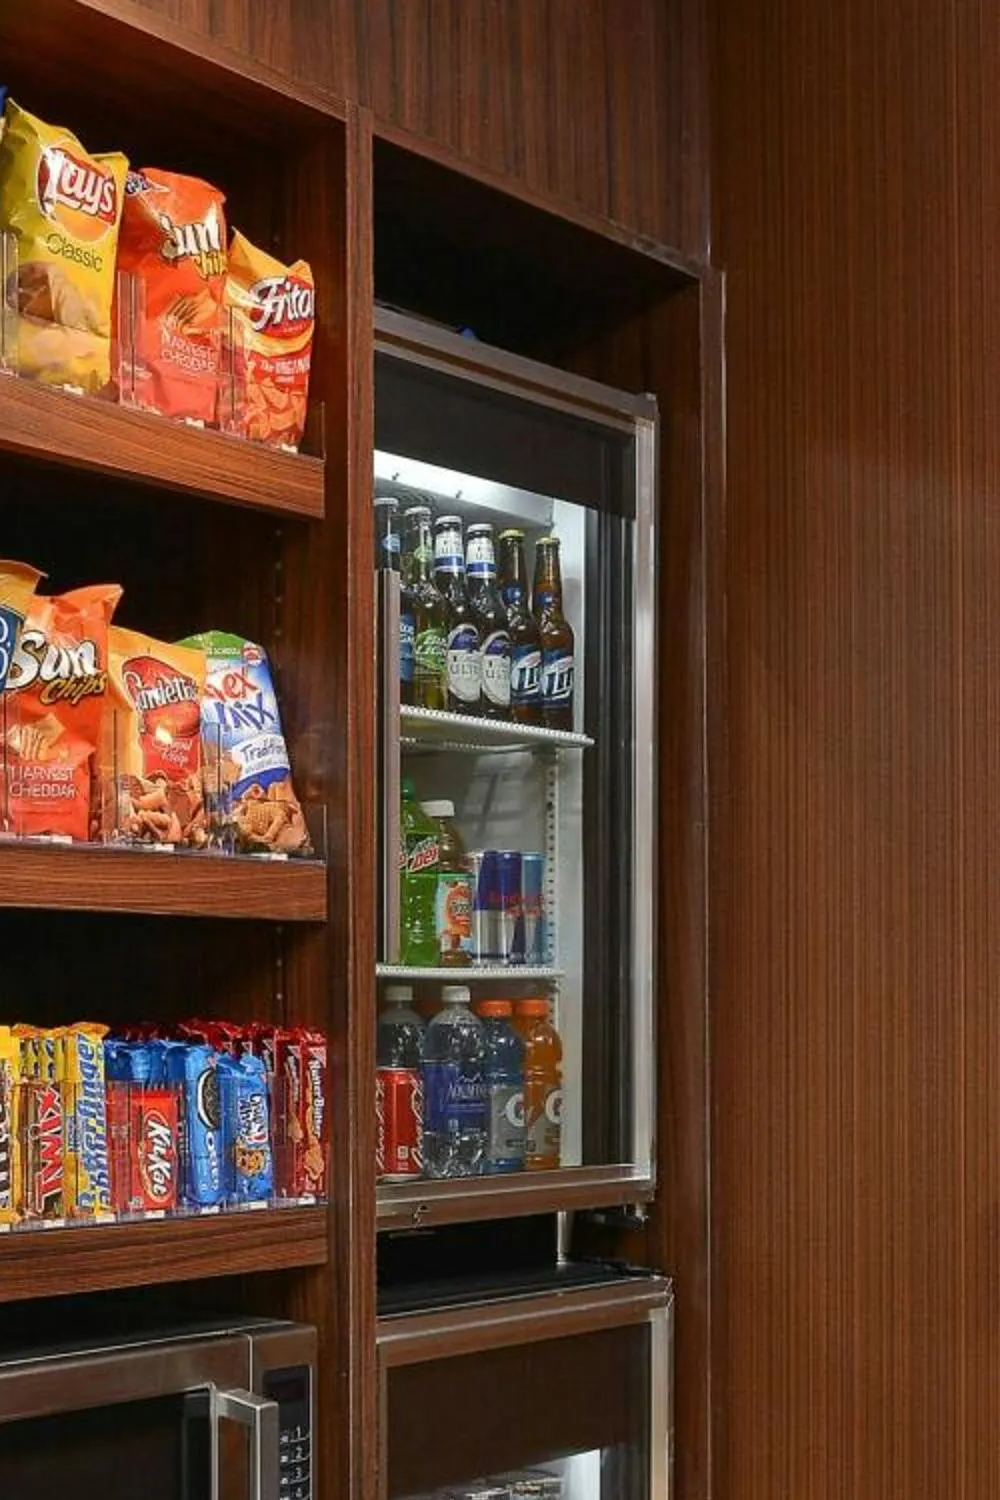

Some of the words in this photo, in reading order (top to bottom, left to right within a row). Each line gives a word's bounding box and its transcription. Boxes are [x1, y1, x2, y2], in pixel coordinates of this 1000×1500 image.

[46, 233, 103, 273] Classic
[4, 630, 101, 690] Sun
[40, 672, 109, 705] Chips
[9, 782, 76, 799] CHEDDAR
